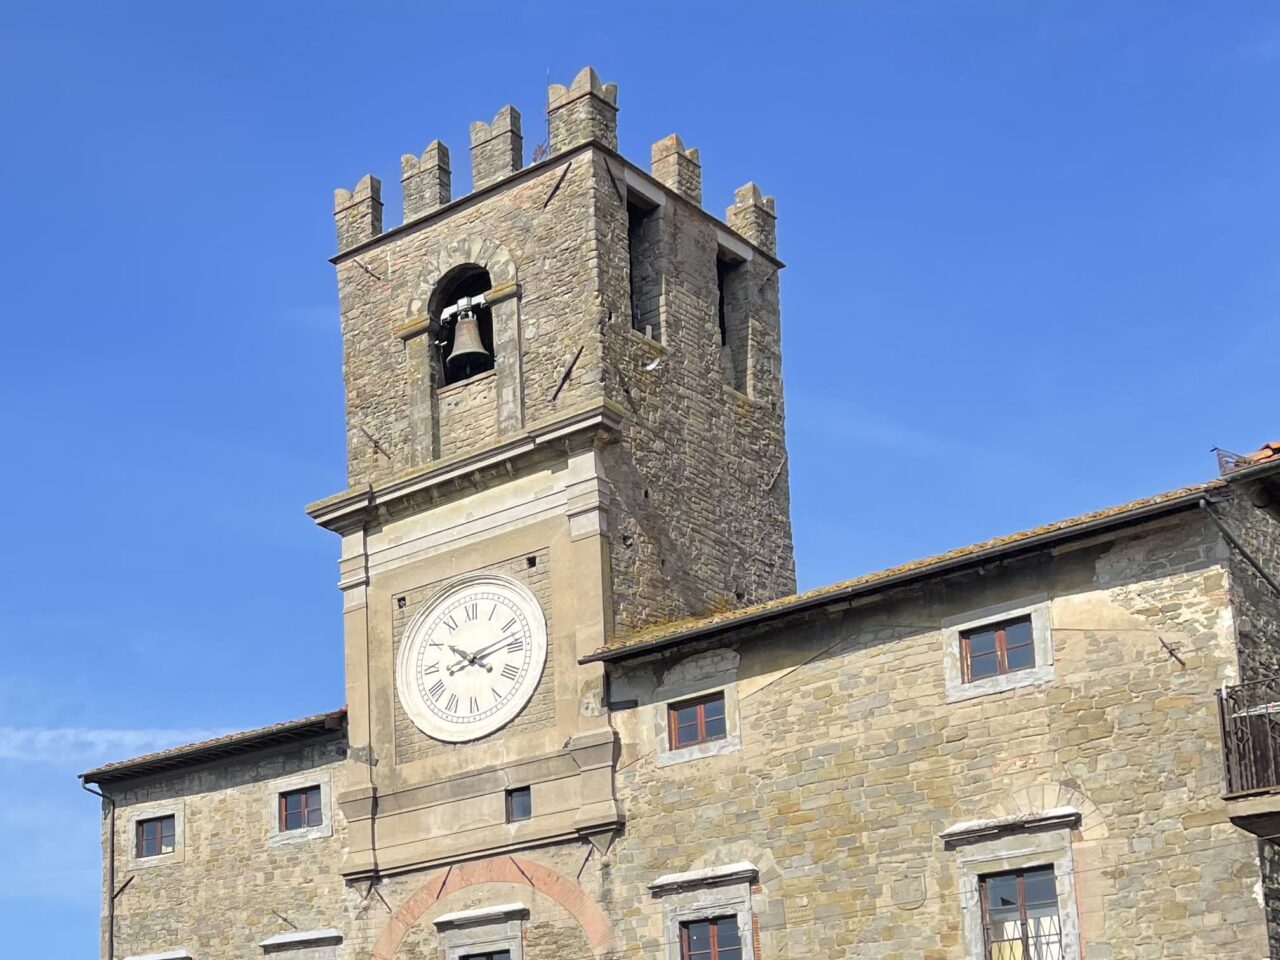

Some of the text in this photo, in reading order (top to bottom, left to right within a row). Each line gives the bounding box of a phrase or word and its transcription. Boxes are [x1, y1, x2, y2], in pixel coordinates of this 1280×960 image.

[464, 603, 478, 623] XII
[488, 604, 498, 621] I
[443, 615, 458, 634] XI
[501, 617, 517, 633] II
[429, 639, 444, 651] X
[445, 693, 459, 713] VII
[491, 687, 502, 702] V
[470, 696, 480, 714] VI
